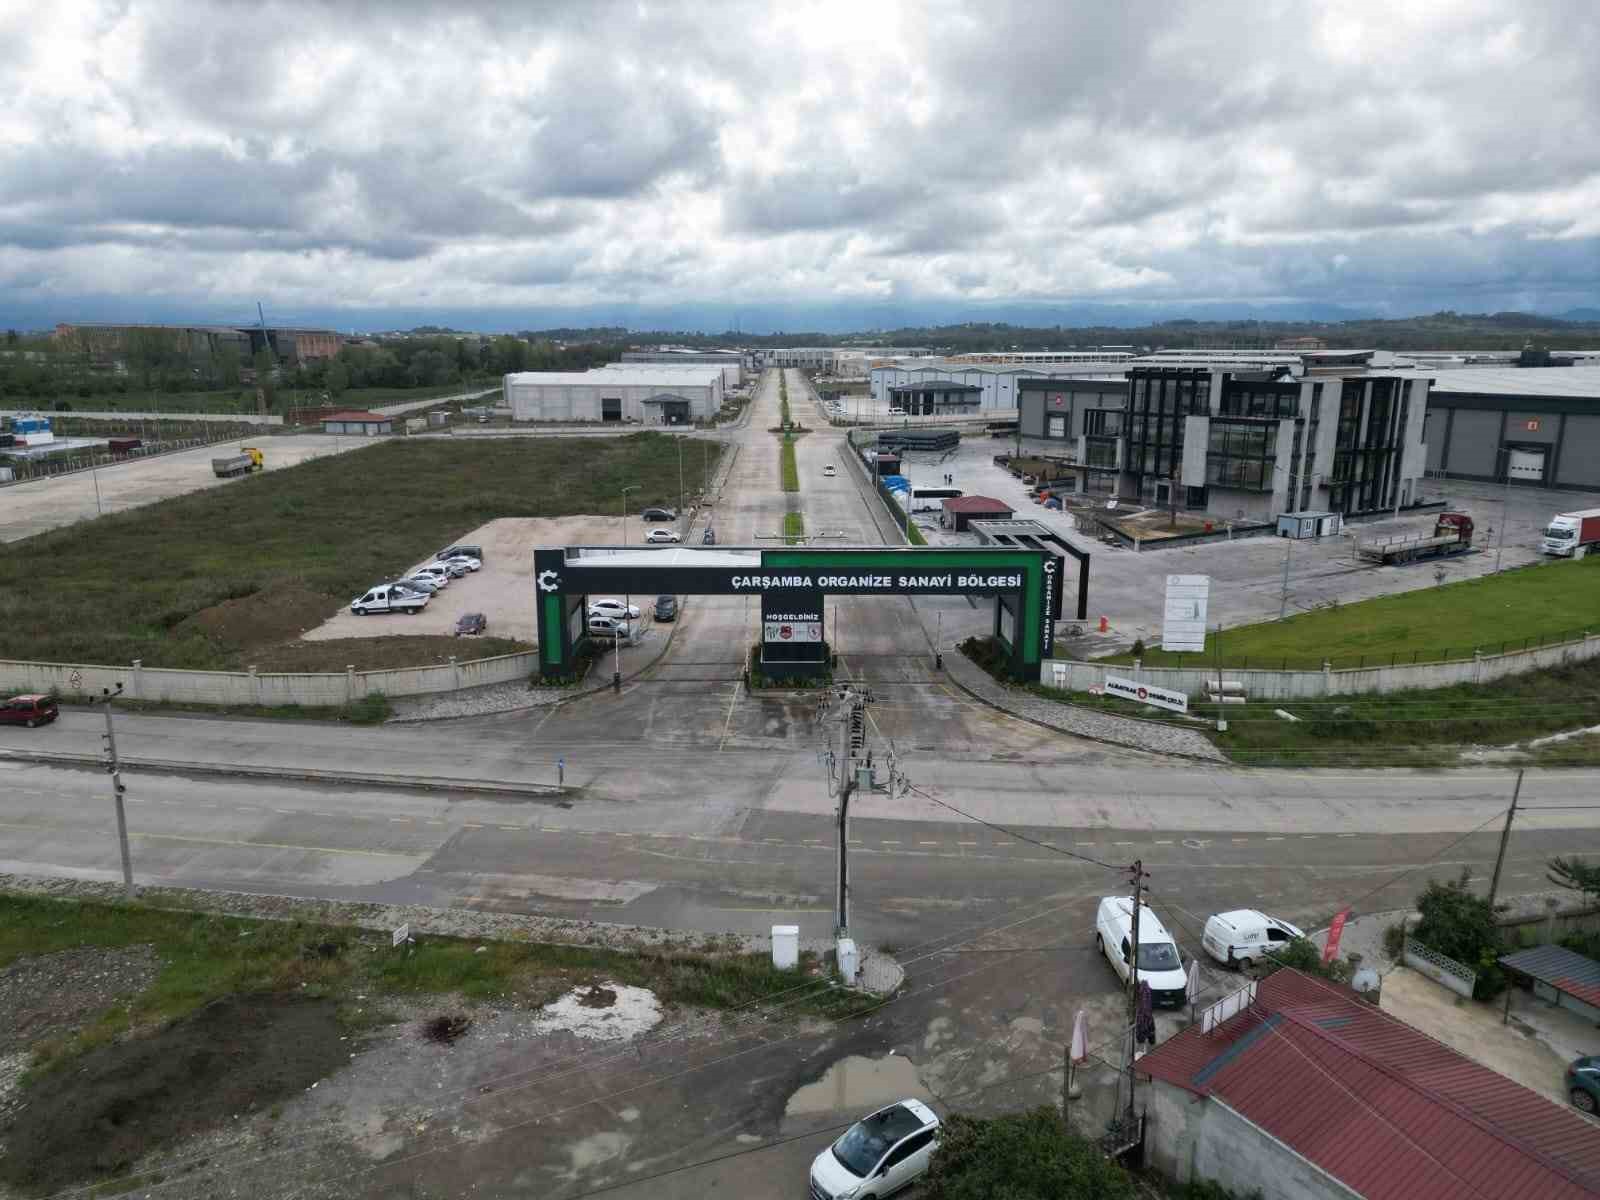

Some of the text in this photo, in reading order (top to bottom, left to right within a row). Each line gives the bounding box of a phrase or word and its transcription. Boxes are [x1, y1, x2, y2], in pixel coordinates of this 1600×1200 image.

[731, 574, 1021, 589] ÇARŞAMBA ORGANİZE SANAYİ BÖLGESİ
